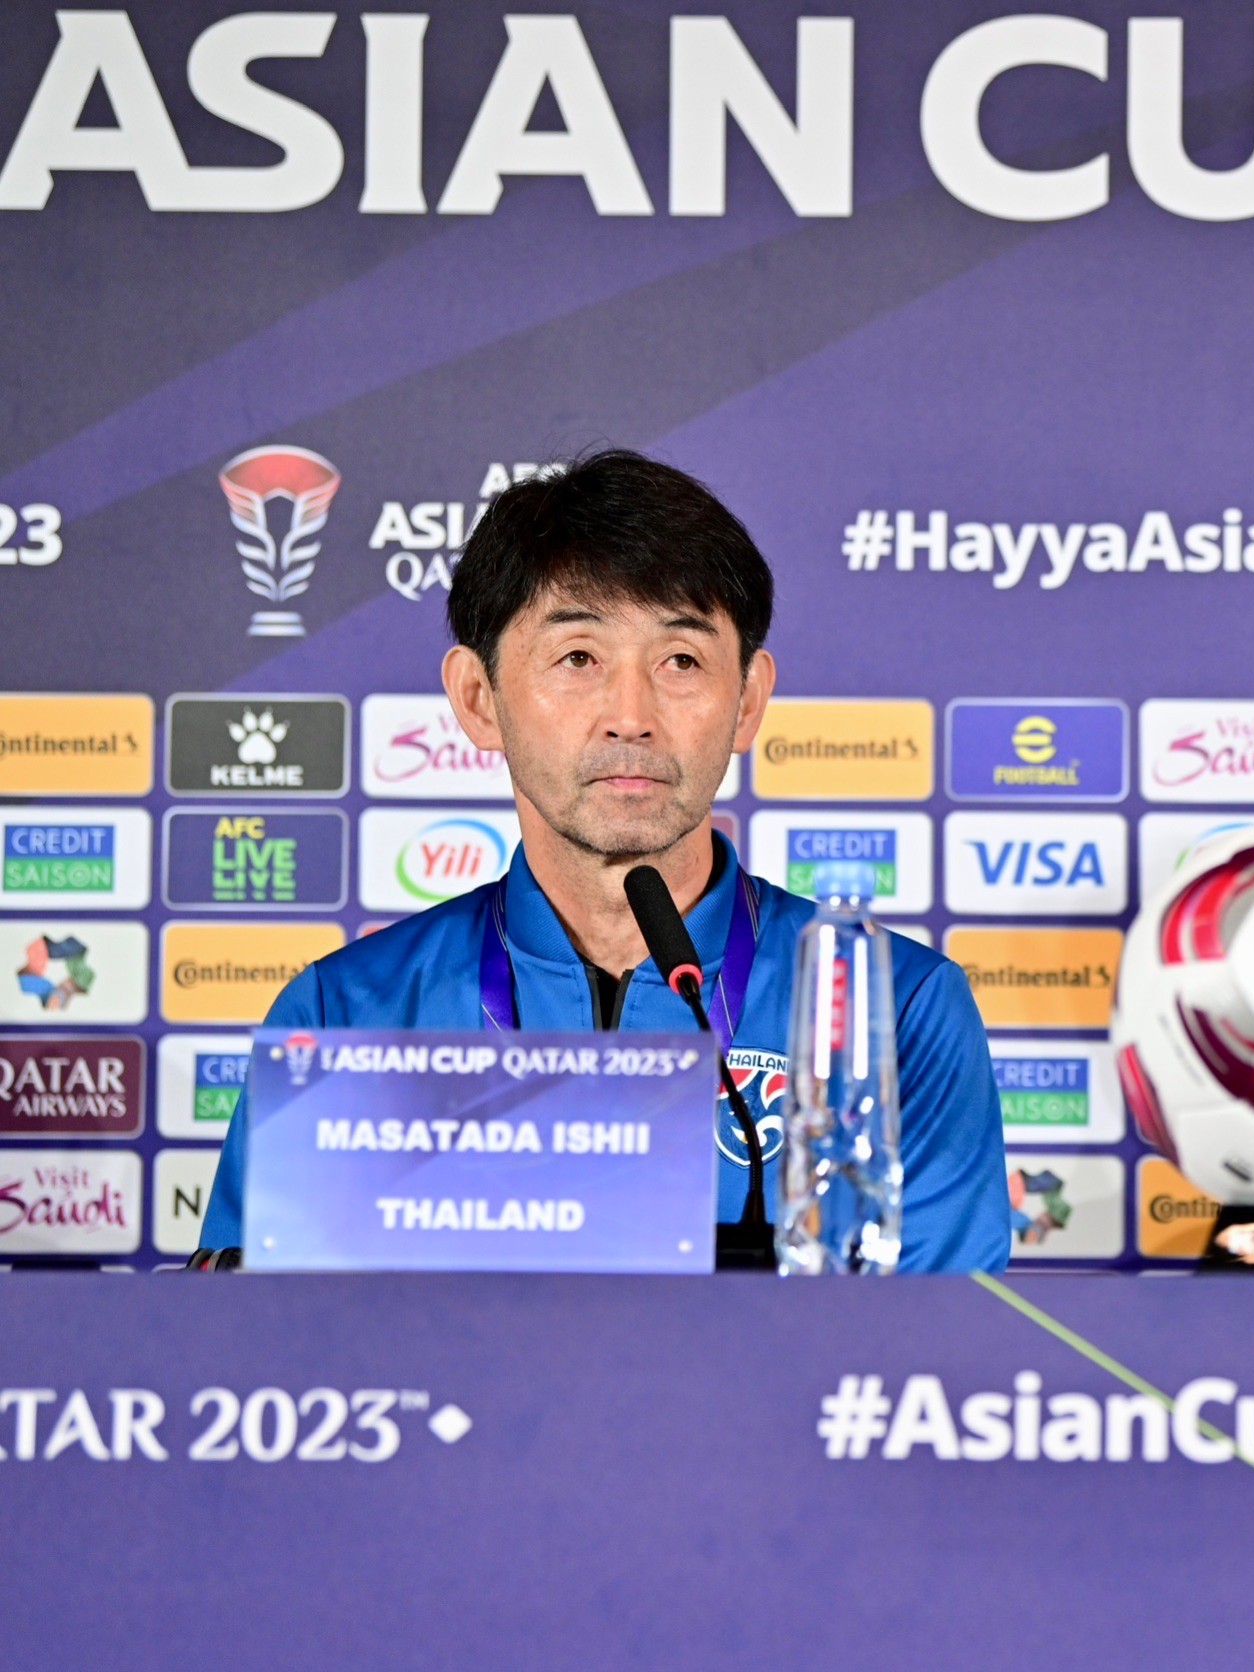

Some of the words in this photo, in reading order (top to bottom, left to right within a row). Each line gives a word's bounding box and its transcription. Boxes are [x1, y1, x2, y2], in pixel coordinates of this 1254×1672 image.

[0, 10, 854, 217] ASIAN
[764, 735, 898, 764] Continental
[210, 765, 304, 787] KELME
[11, 827, 106, 855] CREDIT
[214, 816, 266, 840] AFC
[213, 838, 297, 870] LIVE
[420, 842, 484, 877] Yili
[793, 831, 889, 860] CREDIT
[5, 861, 112, 889] SAISON
[962, 840, 1106, 888] VISA
[334, 1045, 423, 1074] ASIAN
[431, 1046, 497, 1074] CUP
[502, 1048, 599, 1080] QATAR
[13, 1093, 127, 1118] AIRWAYS
[316, 1118, 543, 1154] MASATADA
[553, 1121, 651, 1155] ISHII
[33, 1167, 90, 1188] Visit
[377, 1197, 586, 1232] THAILAND
[0, 1388, 170, 1462] TAR
